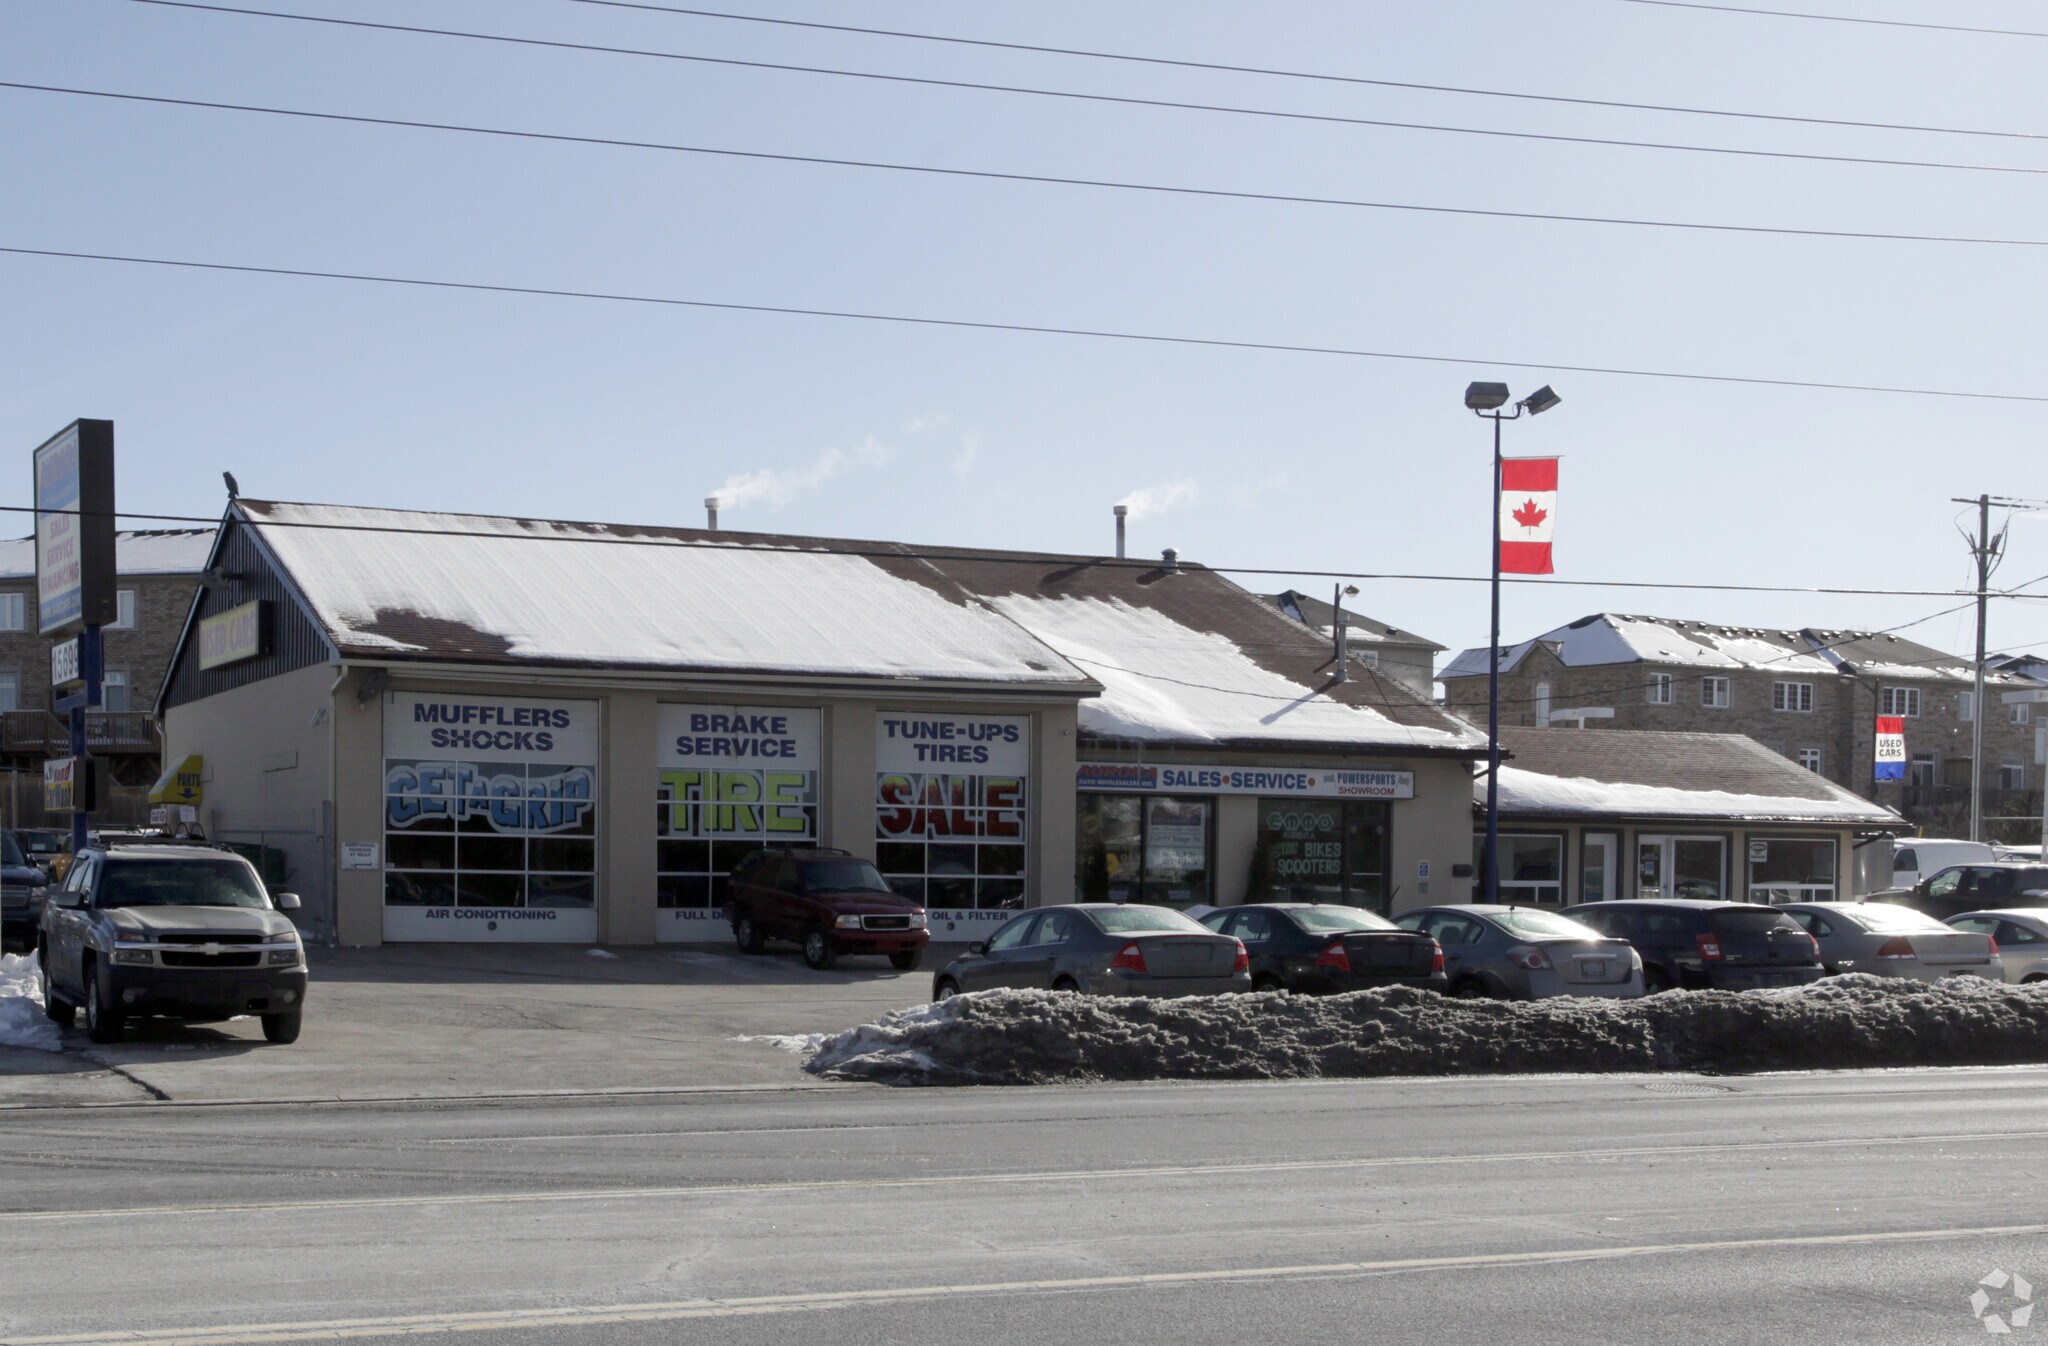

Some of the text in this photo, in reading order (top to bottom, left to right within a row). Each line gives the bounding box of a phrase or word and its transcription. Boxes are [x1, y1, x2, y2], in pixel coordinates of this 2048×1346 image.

[50, 512, 70, 541] SALES
[47, 536, 74, 568] SERVICE
[41, 560, 80, 597] FINANCING
[201, 606, 257, 660] USED CARS
[52, 643, 78, 682] 15699
[414, 703, 570, 728] MUFFLERS
[690, 713, 788, 735] BRAKE
[430, 728, 554, 751] SHOCKS
[883, 719, 1020, 743] TUNE-UPS
[675, 735, 797, 758] SERVICE
[912, 743, 990, 764] TIRES
[1878, 748, 1902, 757] CARS
[1879, 739, 1903, 748] USED
[177, 772, 201, 787] PARTS
[1097, 779, 1140, 787] WHOLESALERS
[1162, 769, 1307, 790] SALES SERVICE
[1337, 772, 1396, 786] POWERSPORTS
[387, 765, 474, 823] GET
[490, 771, 591, 830] GRIP
[659, 770, 807, 833] TIRE
[1338, 786, 1395, 796] SHOWROOM
[878, 773, 1021, 838] SALE
[1304, 842, 1342, 858] BIKES
[425, 909, 557, 920] AIR CONDITIONING
[675, 910, 707, 920] FULL
[931, 911, 1008, 920] OIL & FILTER
